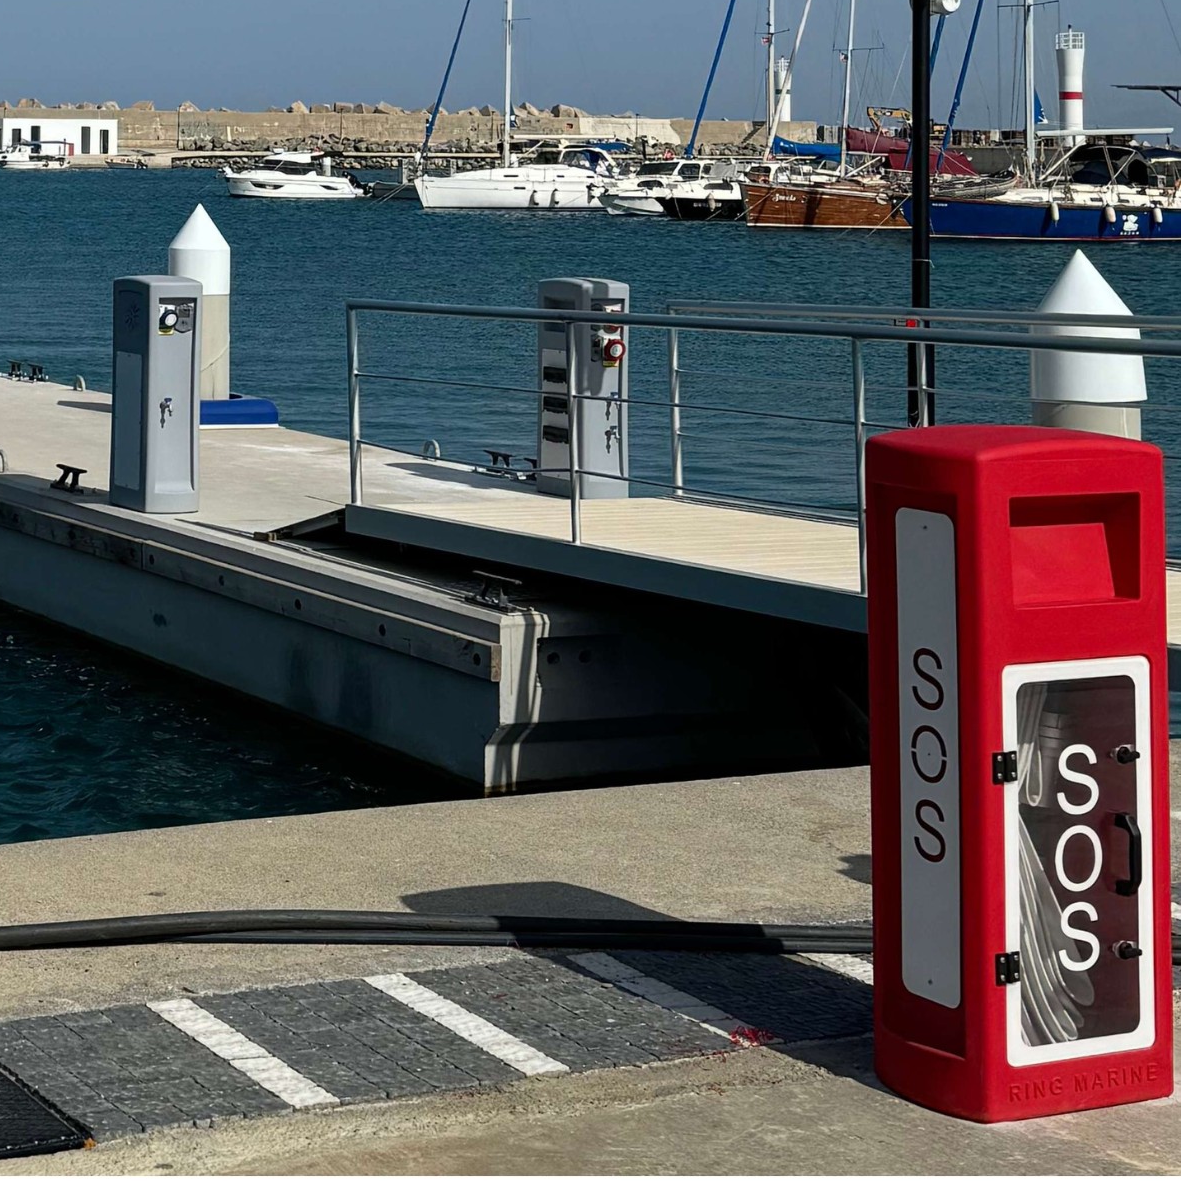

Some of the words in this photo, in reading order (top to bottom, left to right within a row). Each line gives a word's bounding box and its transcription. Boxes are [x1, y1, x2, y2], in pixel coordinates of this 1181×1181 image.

[911, 647, 947, 863] SOS
[1054, 743, 1103, 972] SOS
[1009, 1076, 1063, 1103] RING
[1074, 1062, 1159, 1092] MARINE
